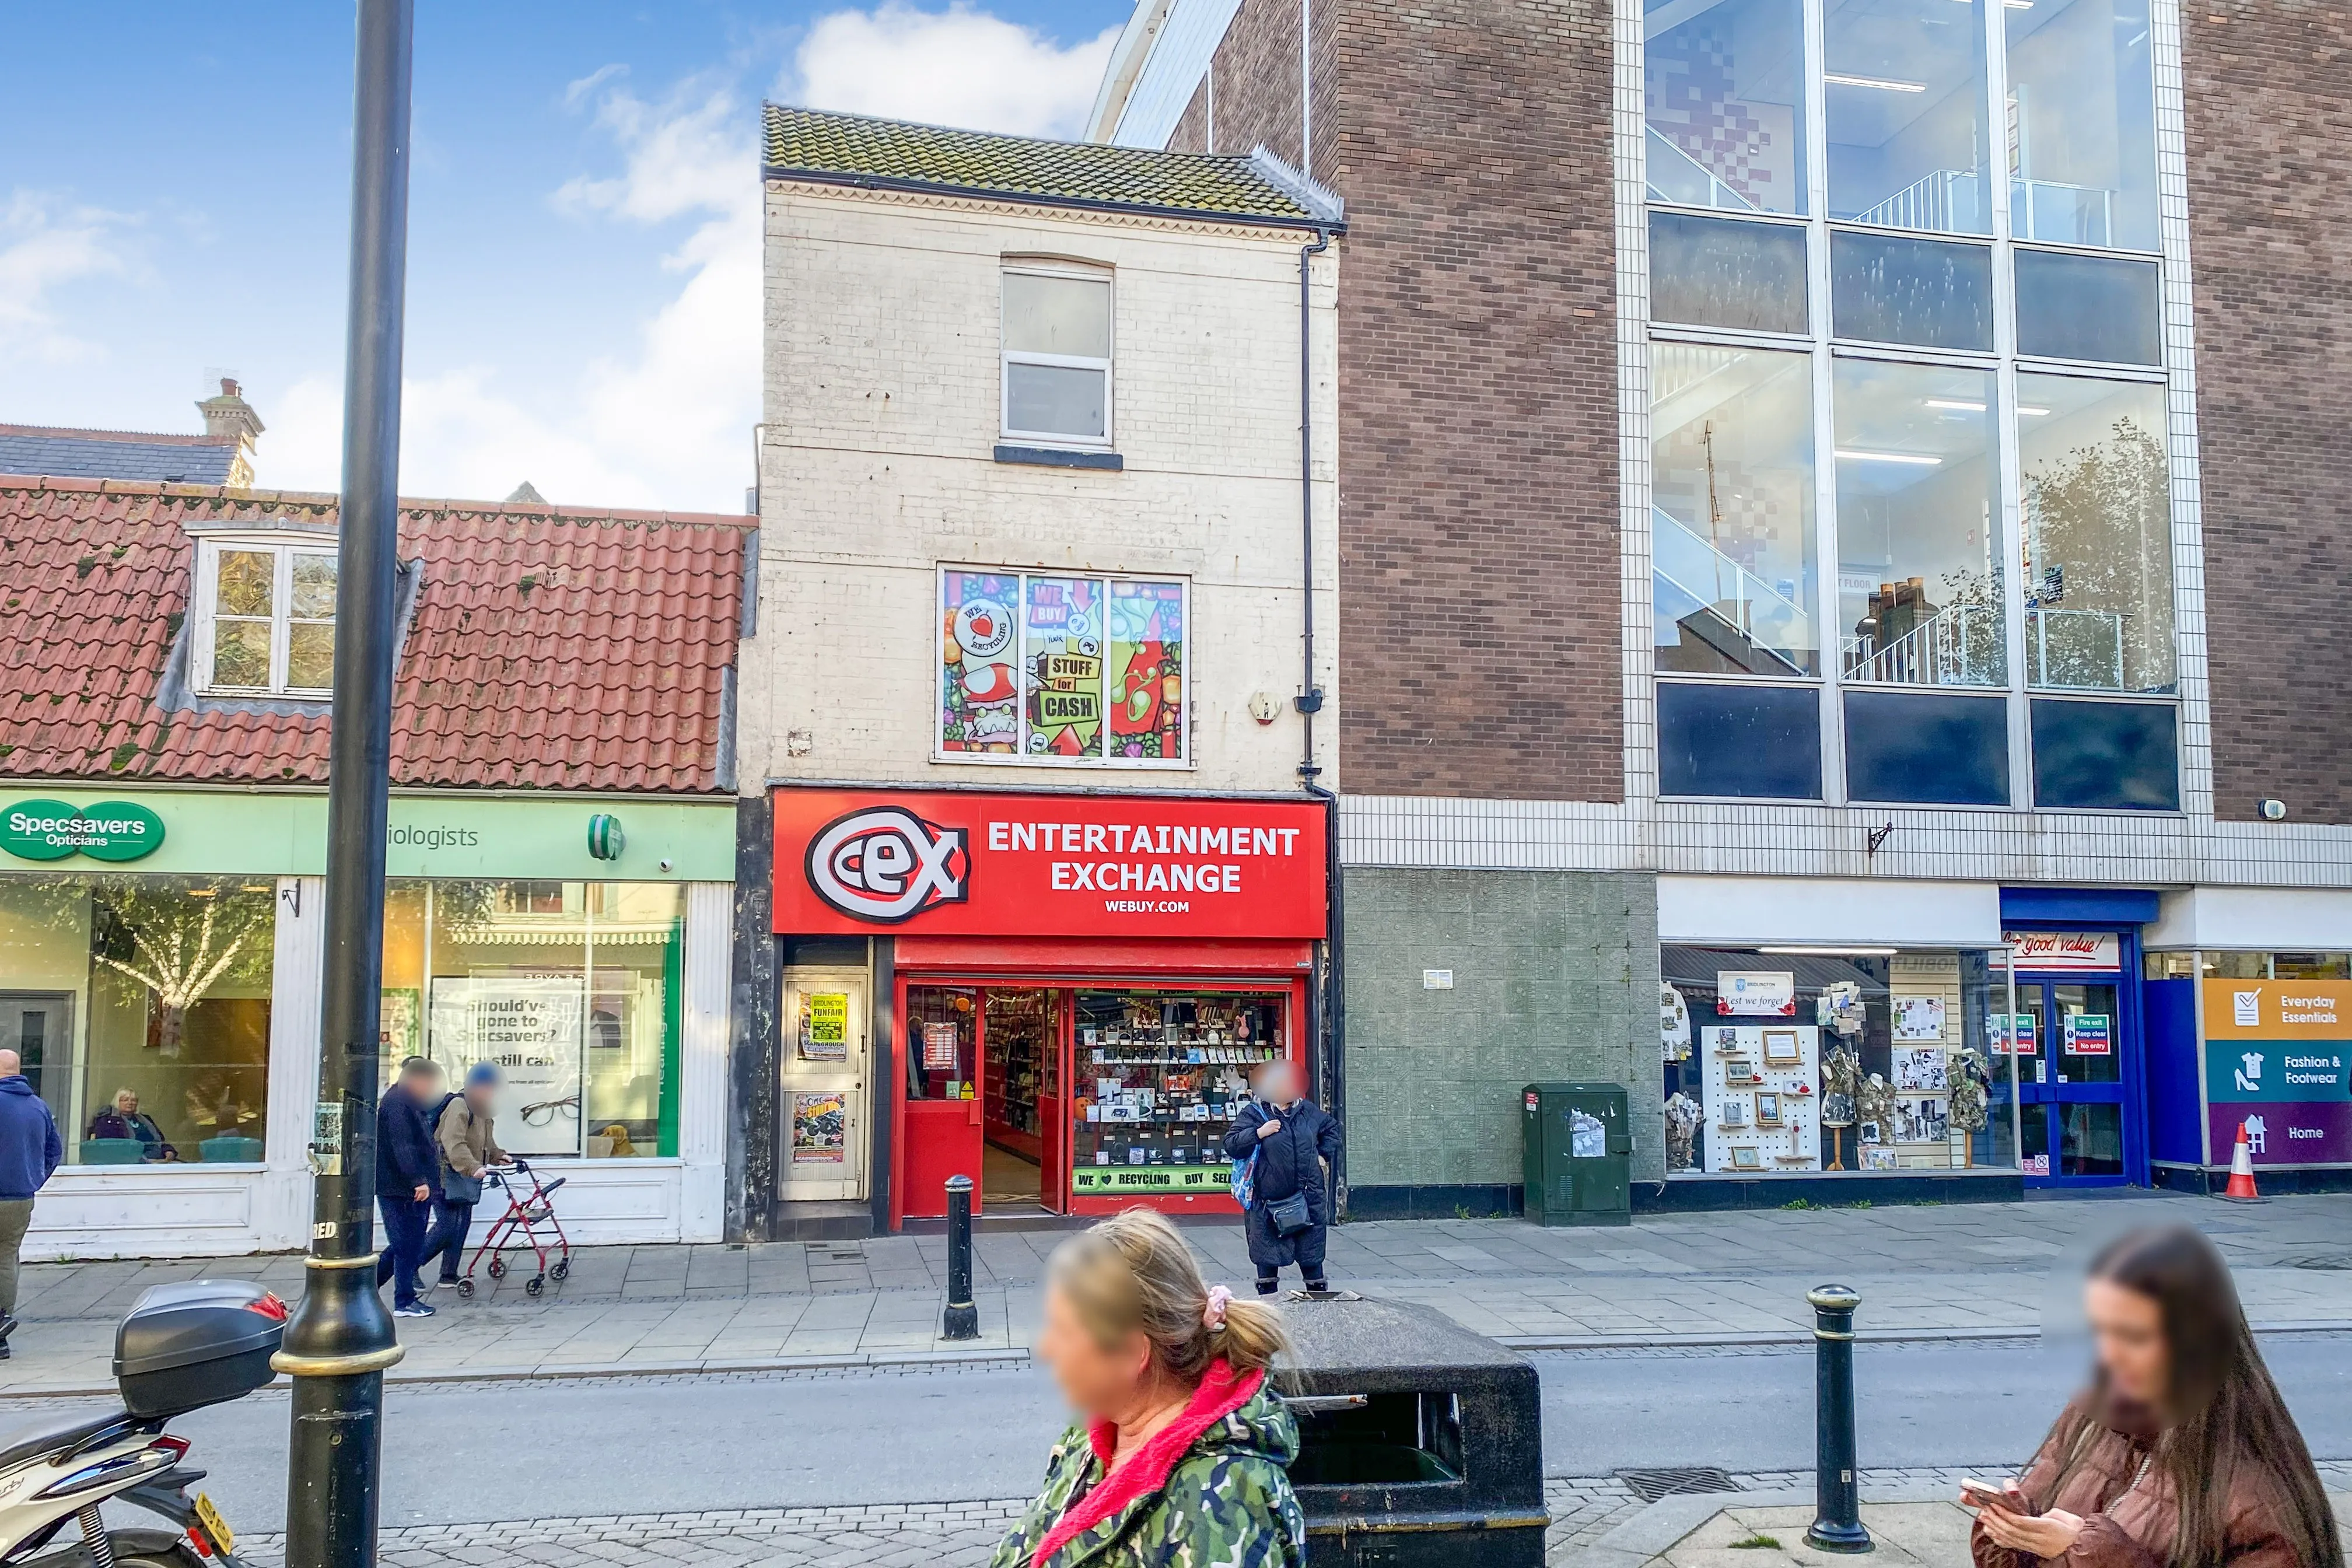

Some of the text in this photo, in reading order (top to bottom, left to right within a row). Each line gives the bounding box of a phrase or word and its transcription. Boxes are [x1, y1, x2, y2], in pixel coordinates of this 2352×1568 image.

[1844, 579, 1871, 589] FLOOR
[1034, 585, 1062, 605] WE
[964, 605, 982, 618] WE
[1038, 607, 1062, 621] BUY
[1052, 658, 1093, 676] STUFF
[1058, 680, 1072, 690] for
[1045, 698, 1093, 717] CASH
[9, 813, 146, 836] Specsavers
[46, 834, 108, 847] Opticians
[388, 824, 478, 850] iologists
[988, 821, 1300, 856] ENTERTAINMENT
[1051, 862, 1241, 893] EXCHANGE
[1105, 899, 1189, 914] WEBUY.COM
[2022, 933, 2059, 956] good
[2060, 933, 2105, 953] value!
[1724, 996, 1741, 1005] Lest
[1758, 996, 1783, 1007] forget
[2281, 996, 2335, 1007] Everyday
[477, 1016, 538, 1030] gone to
[2282, 1012, 2337, 1023] Essentials
[2090, 1042, 2105, 1051] entry
[526, 1056, 554, 1067] can
[2285, 1056, 2341, 1068] Fashion &
[2286, 1072, 2337, 1084] Footwear
[2288, 1127, 2324, 1139] Home
[1079, 1175, 1094, 1185] WE
[1119, 1174, 1170, 1185] RECYCLING
[1185, 1173, 1203, 1184] BUY
